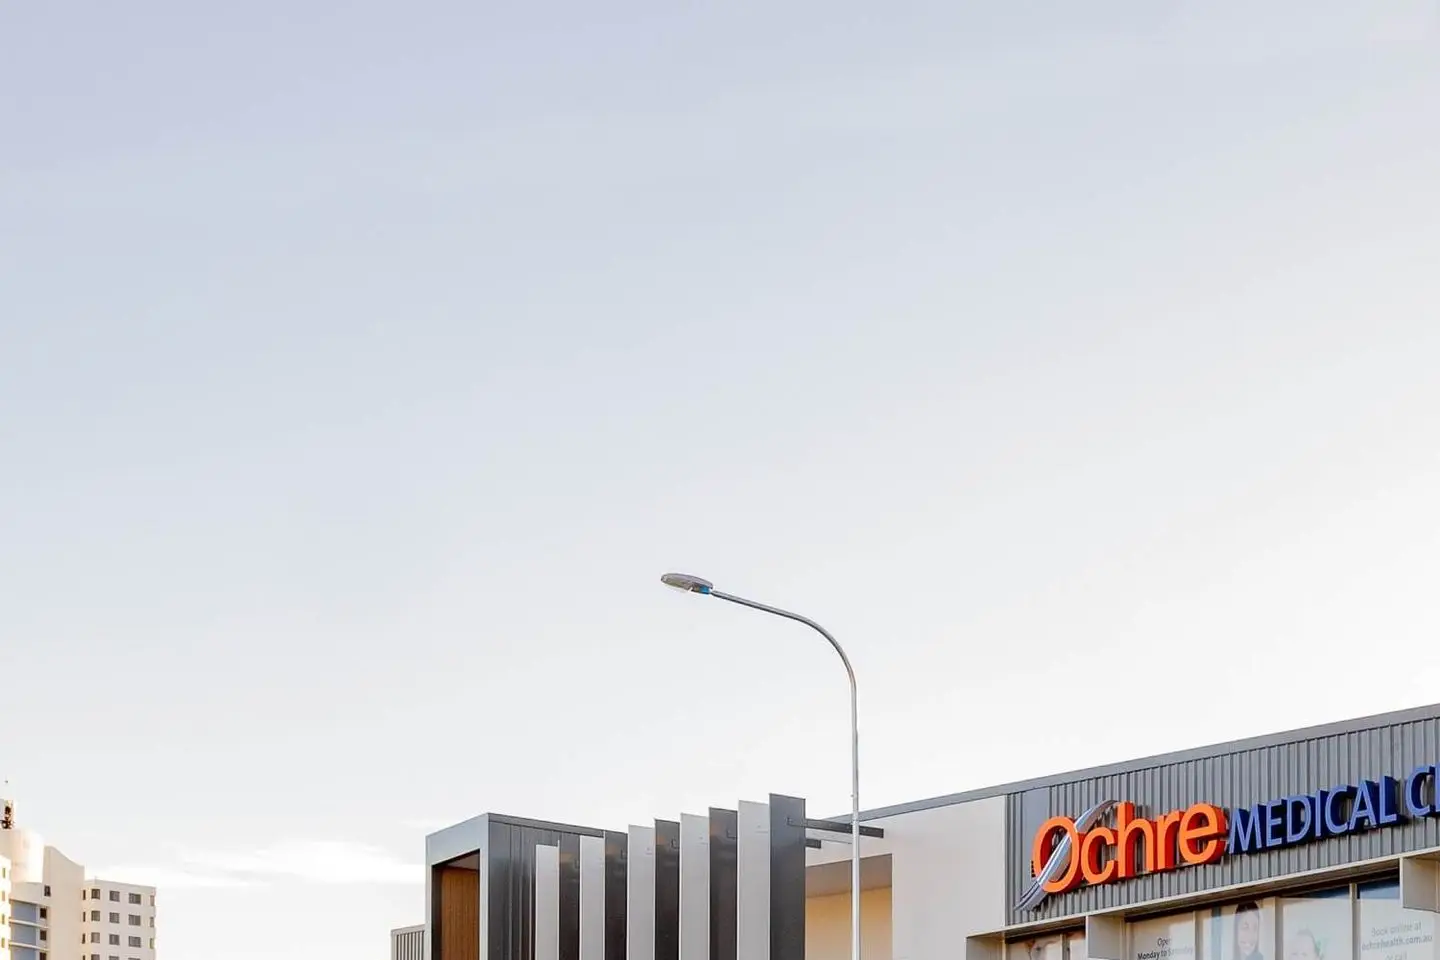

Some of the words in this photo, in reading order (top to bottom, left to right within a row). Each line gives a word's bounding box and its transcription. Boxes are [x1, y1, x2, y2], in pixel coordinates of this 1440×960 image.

[1032, 800, 1227, 893] Ochre
[1229, 776, 1402, 855] MEDICAL
[1137, 951, 1160, 960] Monday
